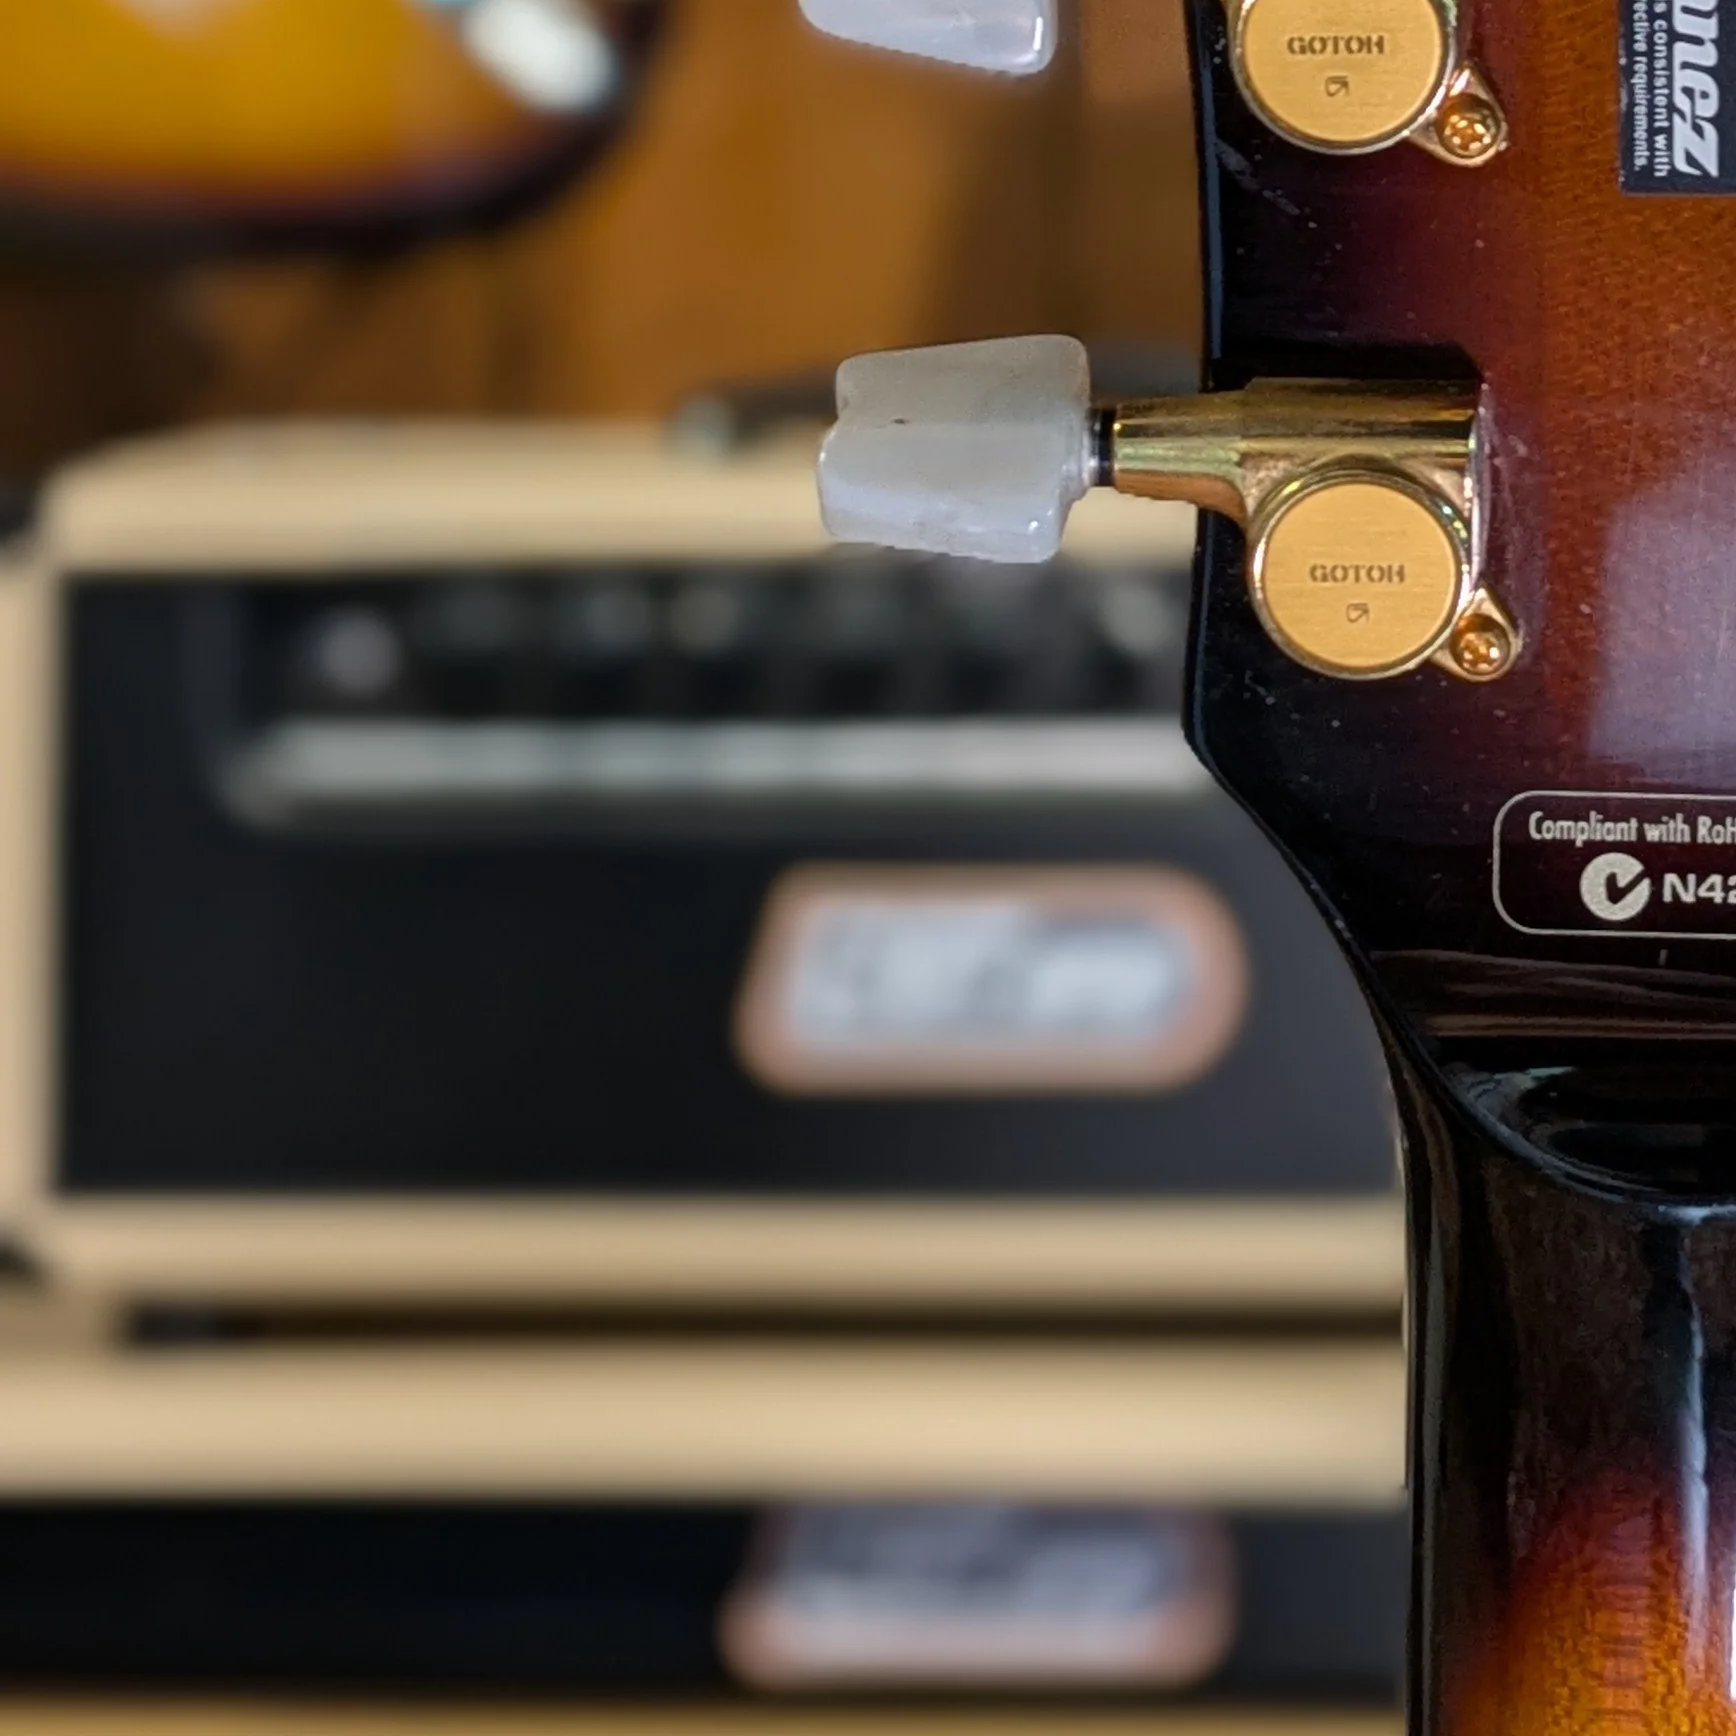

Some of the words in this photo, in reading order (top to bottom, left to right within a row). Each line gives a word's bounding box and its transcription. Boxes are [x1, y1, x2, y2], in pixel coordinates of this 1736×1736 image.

[1286, 35, 1385, 55] GOTOH
[1654, 19, 1671, 128] consistent
[1630, 56, 1650, 171] requirements.
[1654, 133, 1671, 177] with
[1309, 564, 1405, 583] GOTOH
[1528, 810, 1638, 848] Compliant
[1643, 813, 1691, 844] with
